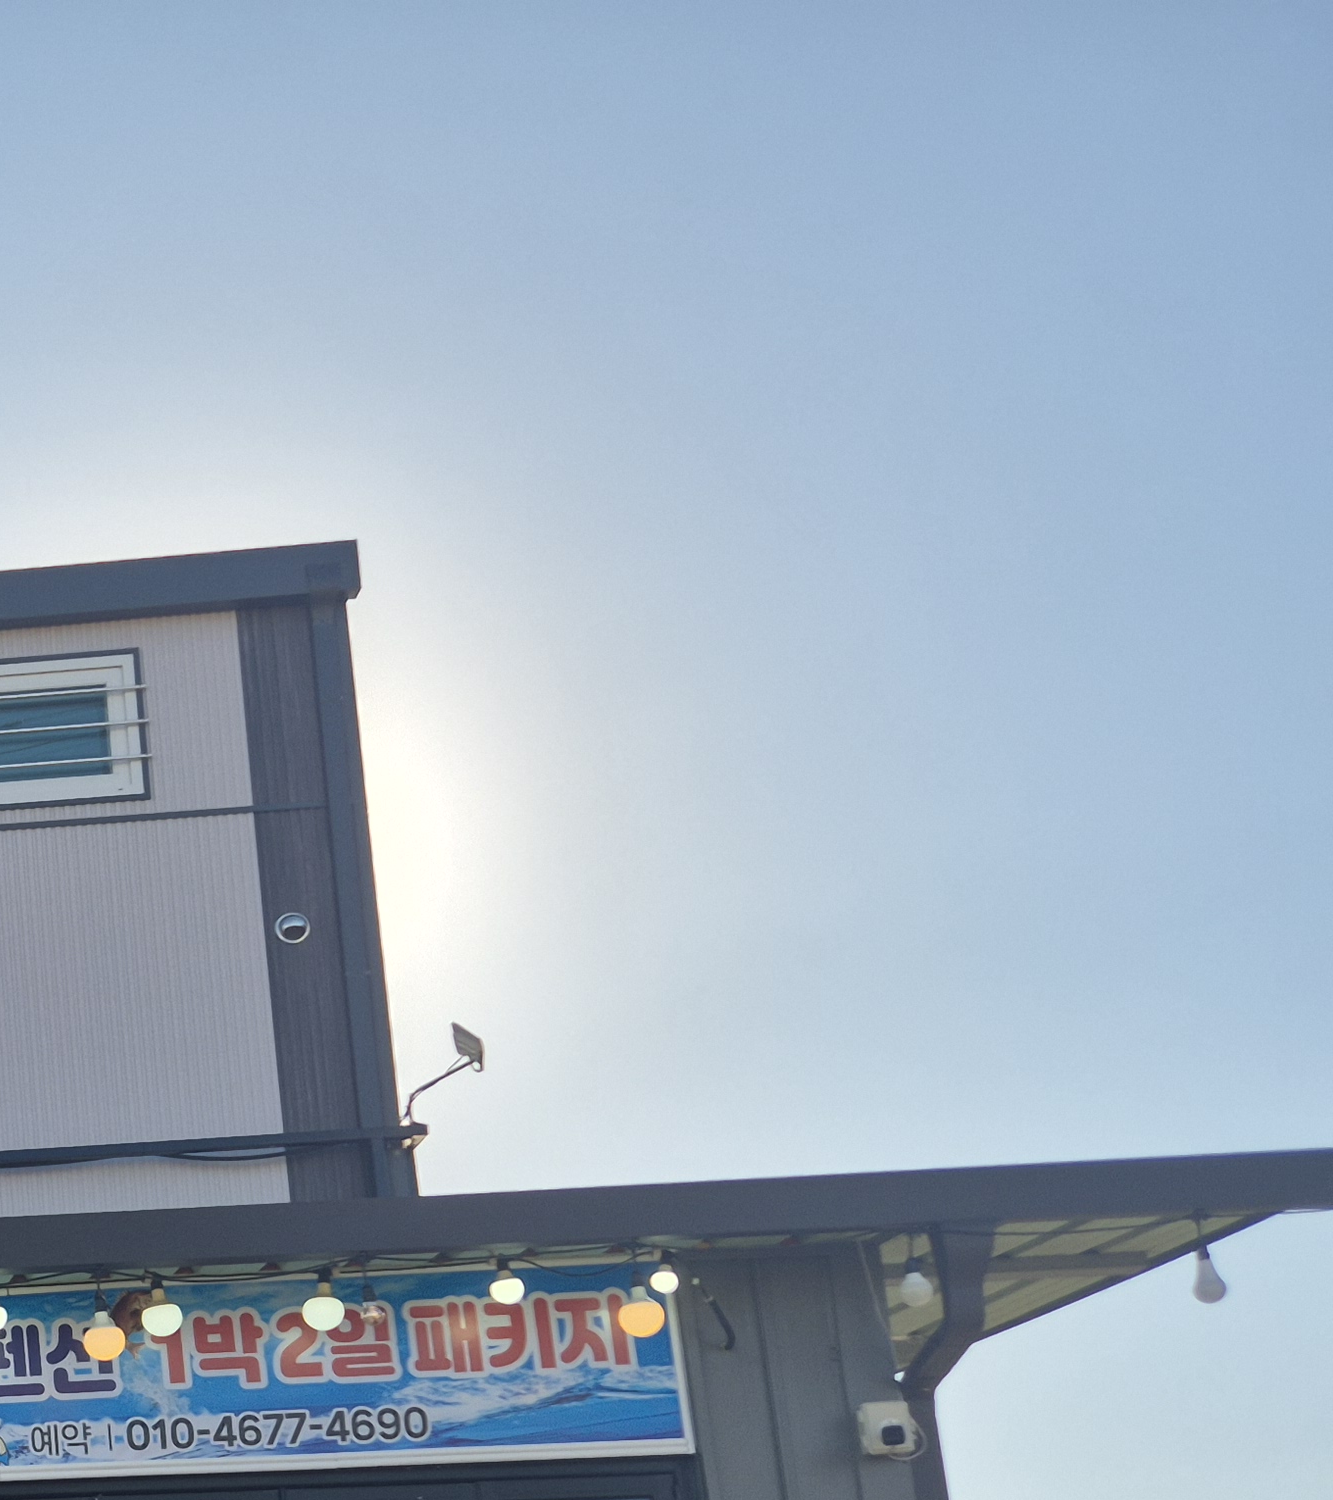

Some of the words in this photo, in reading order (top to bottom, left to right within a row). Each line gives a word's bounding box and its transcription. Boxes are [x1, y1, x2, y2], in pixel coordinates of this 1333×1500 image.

[150, 1312, 264, 1384] 1박
[275, 1305, 396, 1378] 2일
[409, 1293, 632, 1373] 패키지
[33, 1424, 91, 1457] 예약
[126, 1406, 428, 1451] 010-4677-4690
